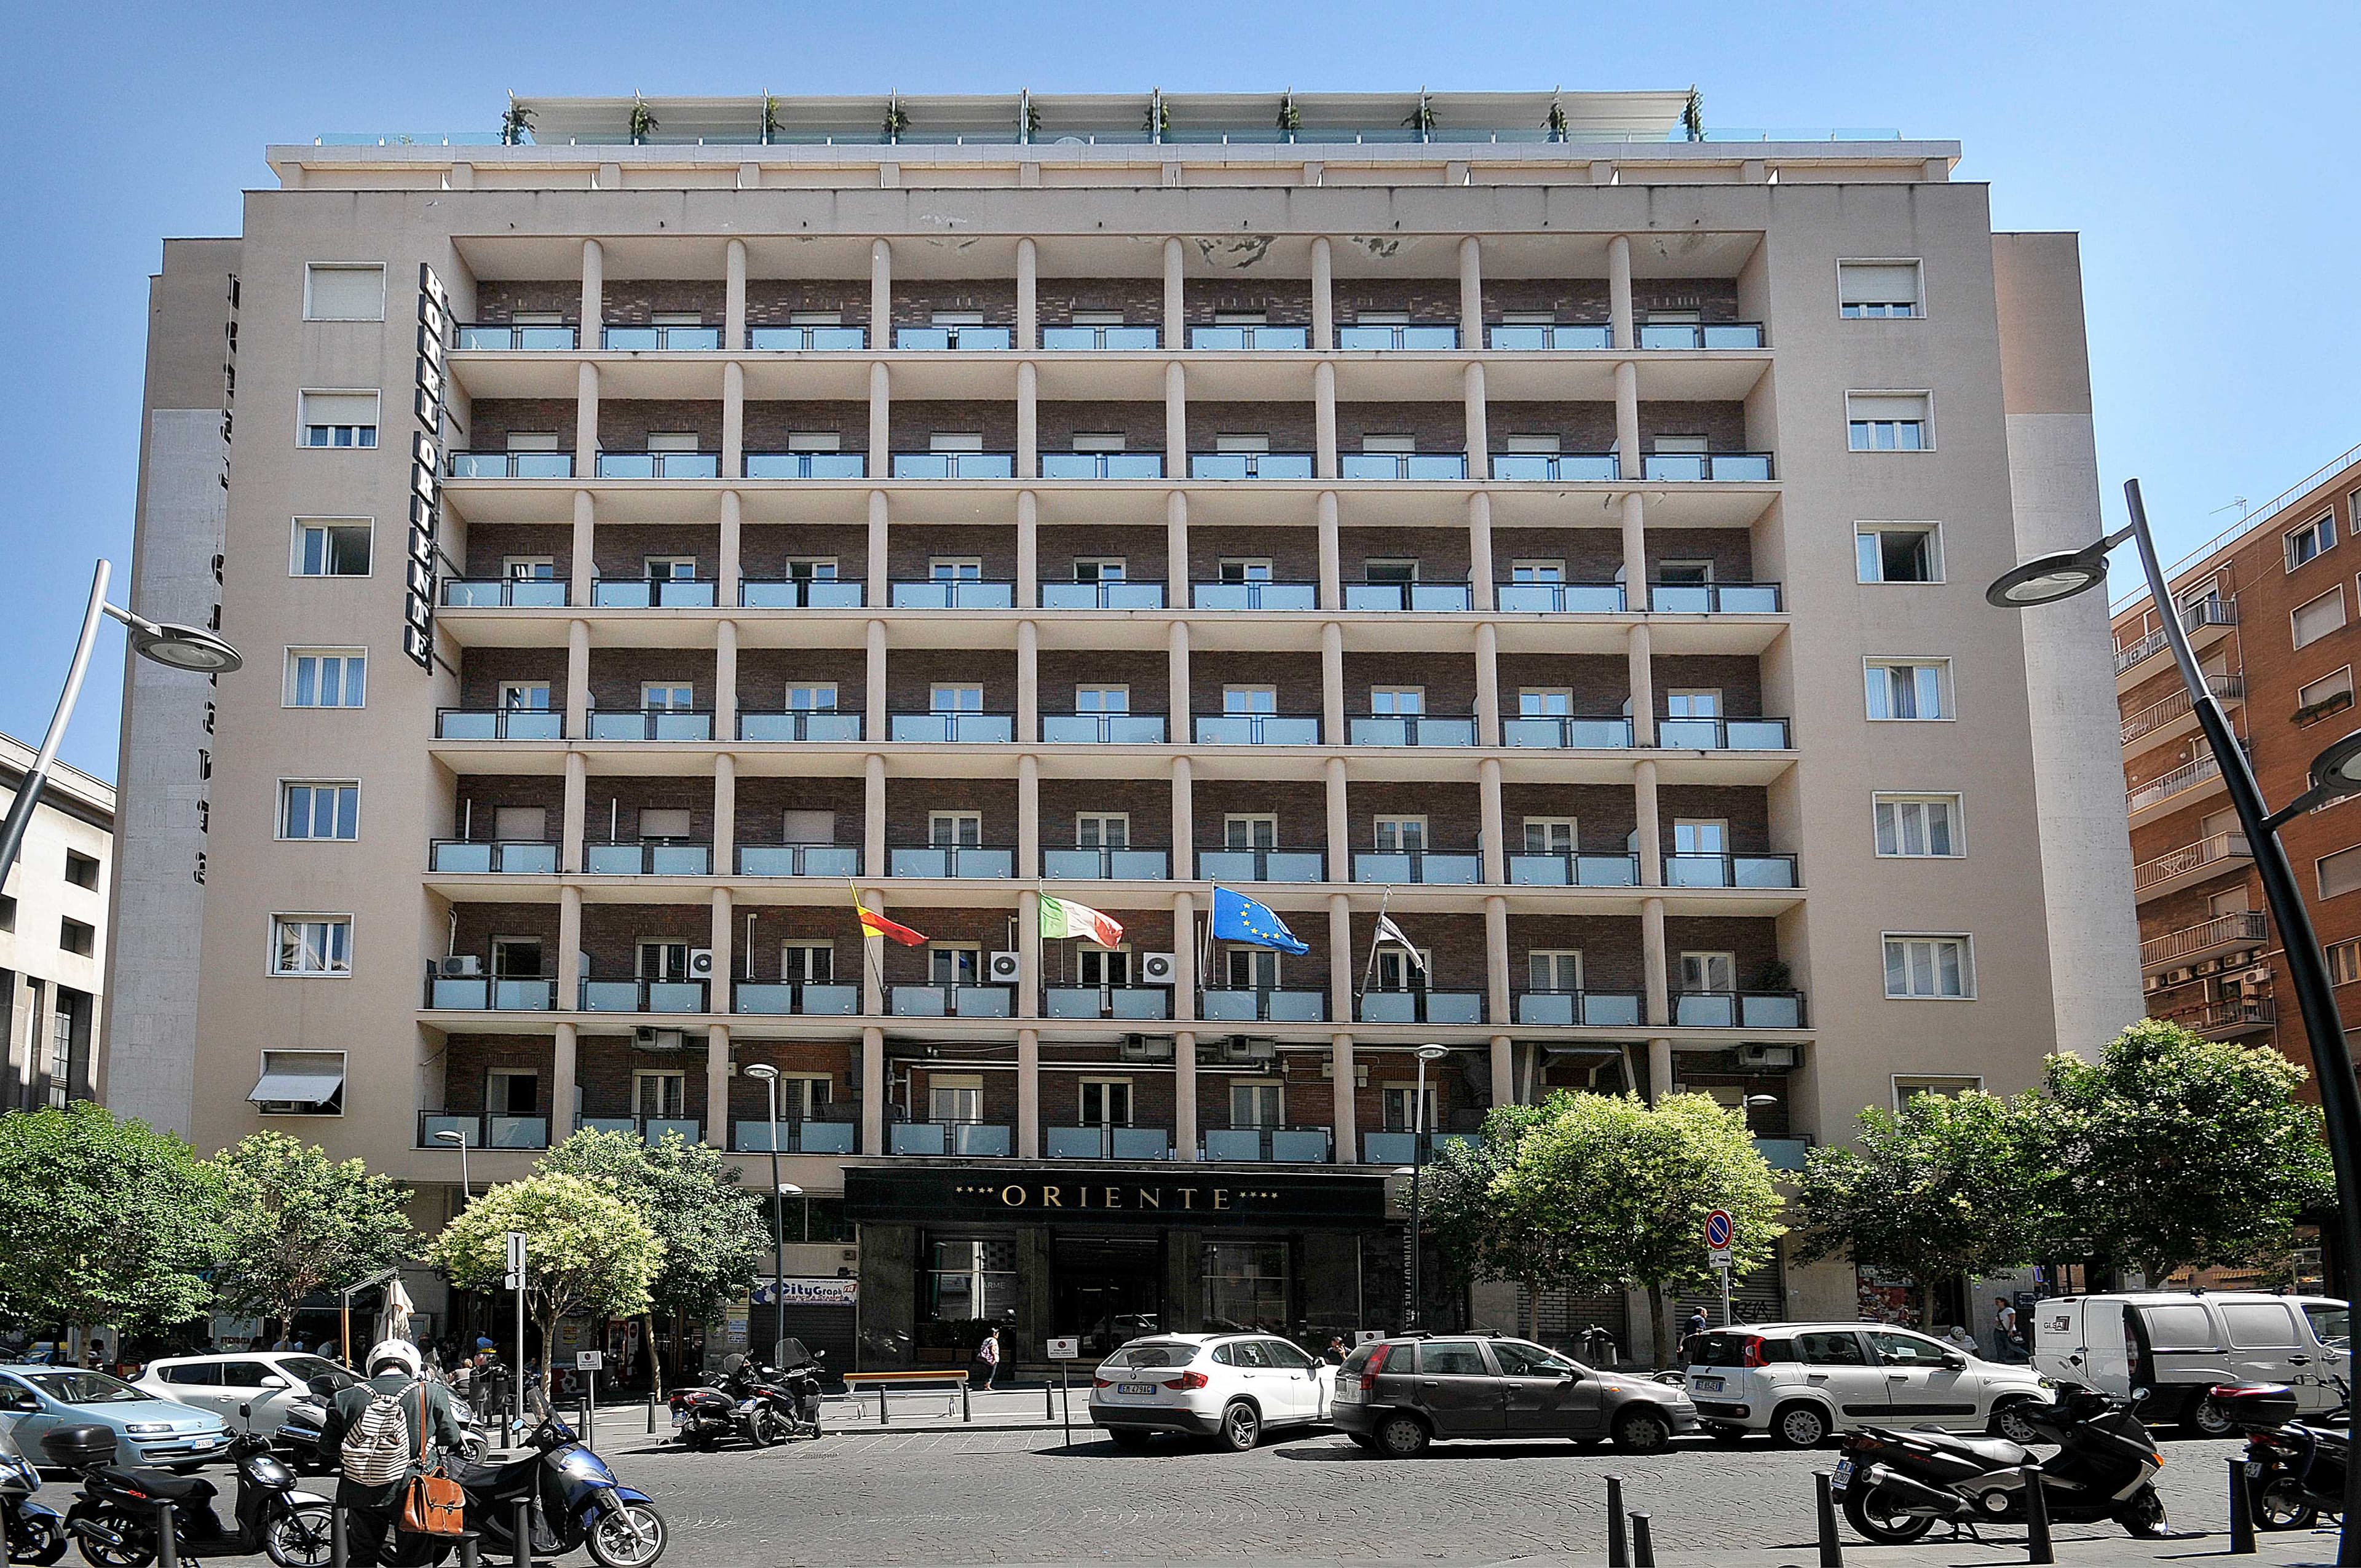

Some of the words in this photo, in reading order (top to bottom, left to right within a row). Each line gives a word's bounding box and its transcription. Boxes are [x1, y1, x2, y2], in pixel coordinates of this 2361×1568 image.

[419, 265, 444, 432] HOTEL
[409, 437, 437, 663] ORIENTE
[1002, 1185, 1230, 1210] ORIENTE
[770, 1282, 842, 1297] CityGraph
